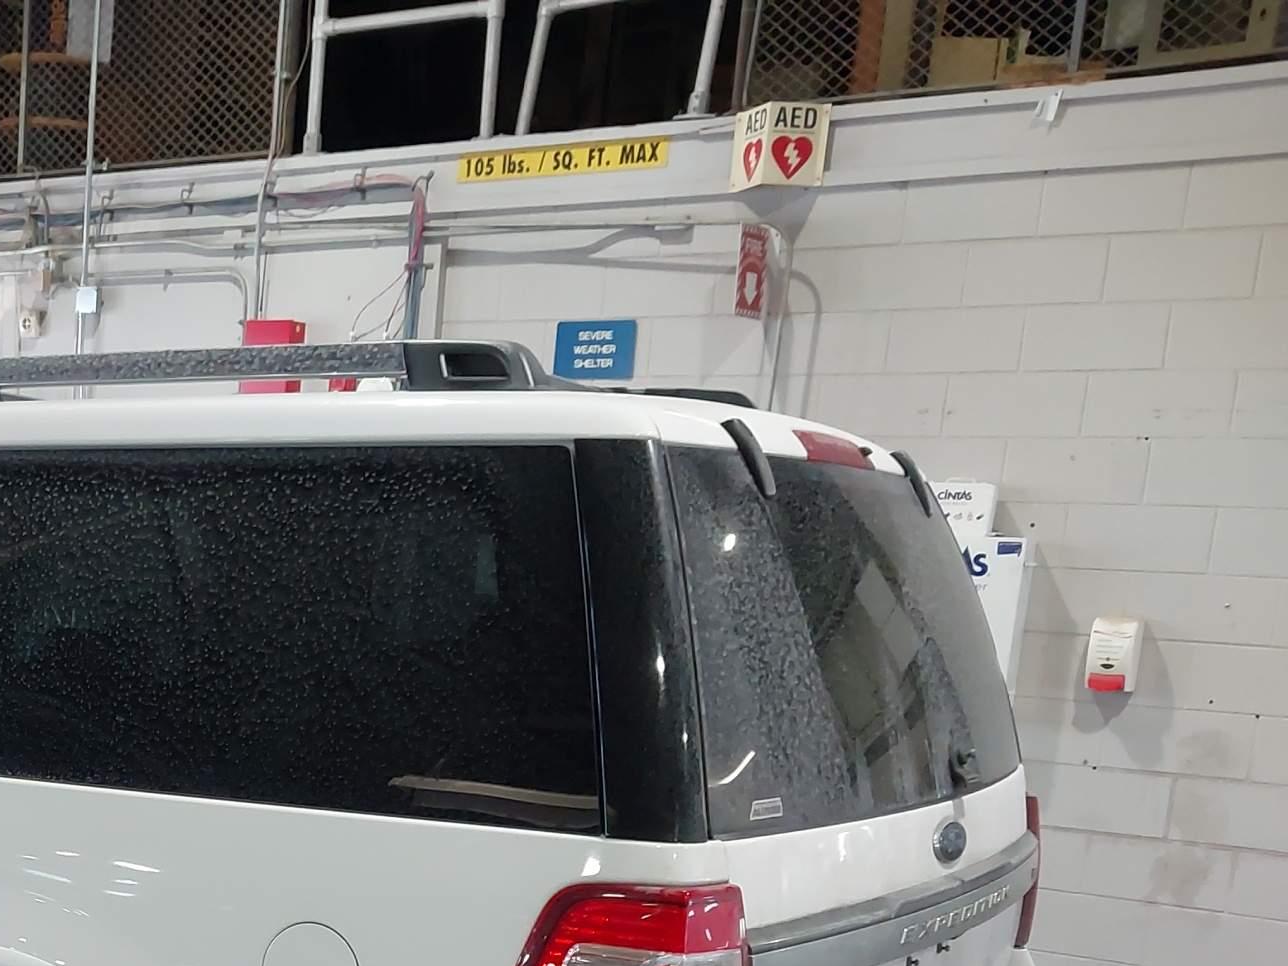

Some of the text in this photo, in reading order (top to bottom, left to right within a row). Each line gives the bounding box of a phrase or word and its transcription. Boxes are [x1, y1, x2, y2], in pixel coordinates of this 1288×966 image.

[745, 108, 767, 135] AED
[774, 106, 818, 129] AED
[465, 142, 661, 178] 105 lbs. / SQ. FT. MAX
[578, 329, 614, 341] SEVERE
[573, 344, 617, 355] WEATHER
[573, 358, 614, 369] SHELTER
[937, 489, 973, 501] CINTAS
